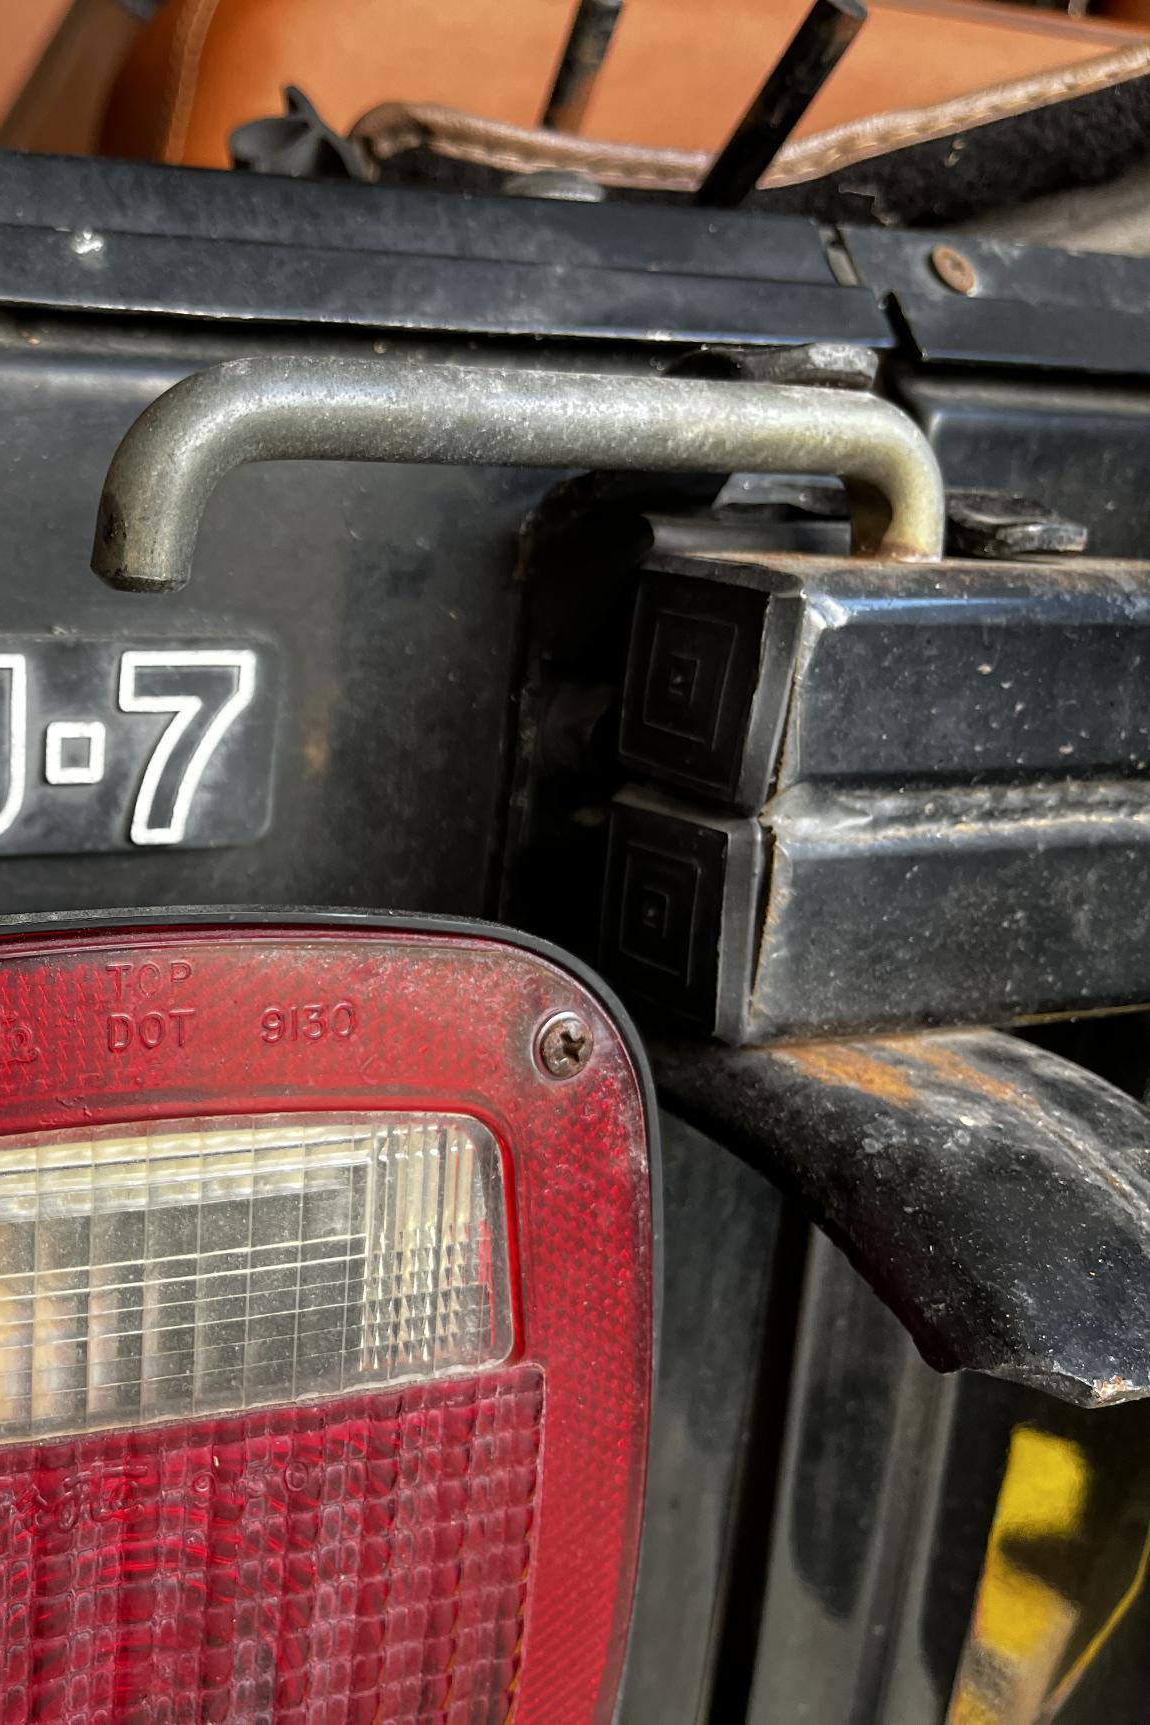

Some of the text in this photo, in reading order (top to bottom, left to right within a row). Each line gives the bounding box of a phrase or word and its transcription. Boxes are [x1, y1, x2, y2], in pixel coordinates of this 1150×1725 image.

[105, 959, 193, 1000] TOP
[106, 1007, 195, 1053] DOT
[260, 1001, 358, 1044] 9130
